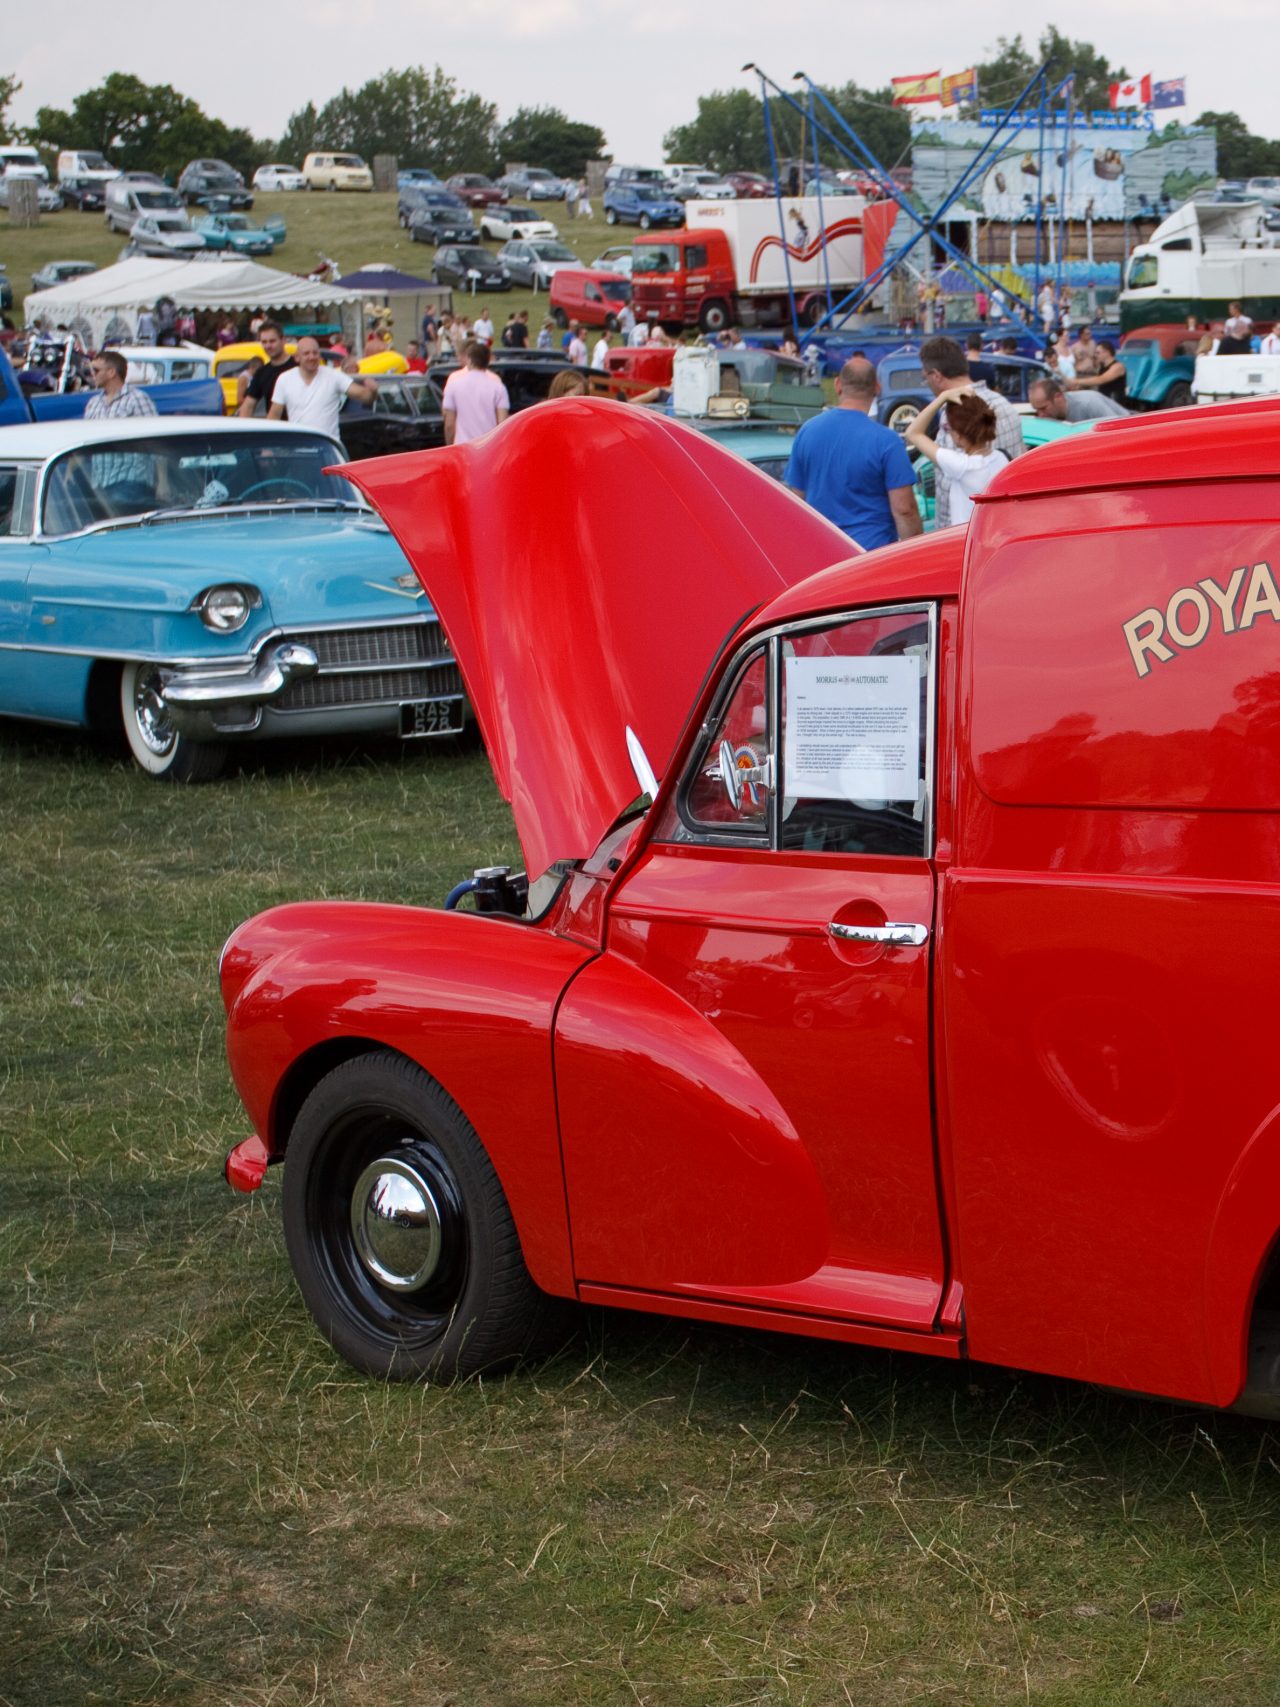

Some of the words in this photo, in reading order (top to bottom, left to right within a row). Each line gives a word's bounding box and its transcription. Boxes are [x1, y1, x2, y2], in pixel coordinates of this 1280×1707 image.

[815, 676, 838, 684] MORRIS
[855, 675, 889, 684] AUTOMATIC
[414, 701, 450, 718] RAS
[414, 716, 450, 734] 578
